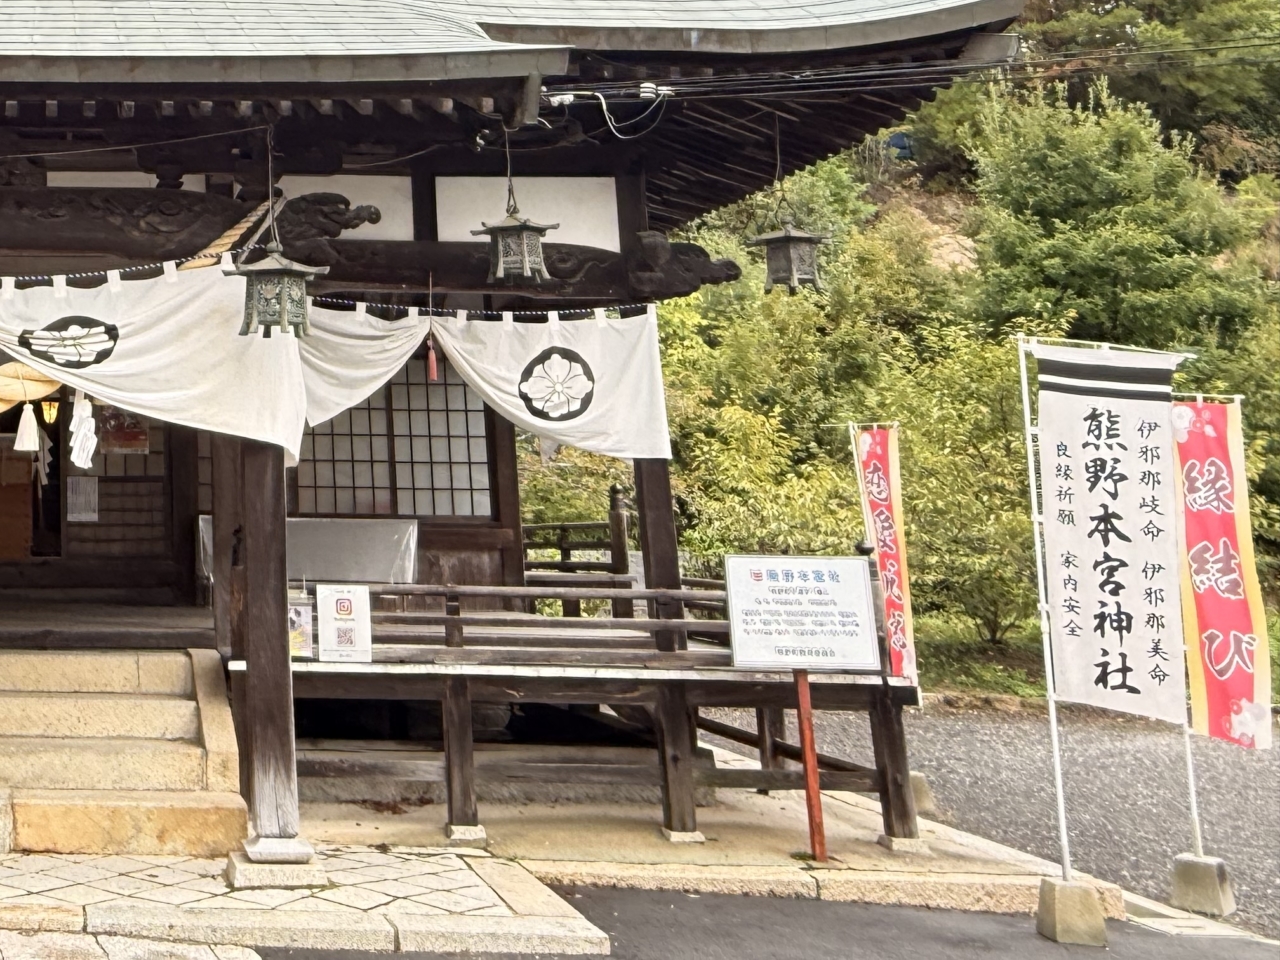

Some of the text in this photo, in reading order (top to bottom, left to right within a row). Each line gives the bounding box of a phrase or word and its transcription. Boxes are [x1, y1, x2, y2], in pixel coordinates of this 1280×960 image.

[1054, 441, 1083, 638] 良縁祈願 家内安全
[1081, 407, 1141, 694] 熊野本宮神社
[1182, 457, 1257, 680] 縁結び
